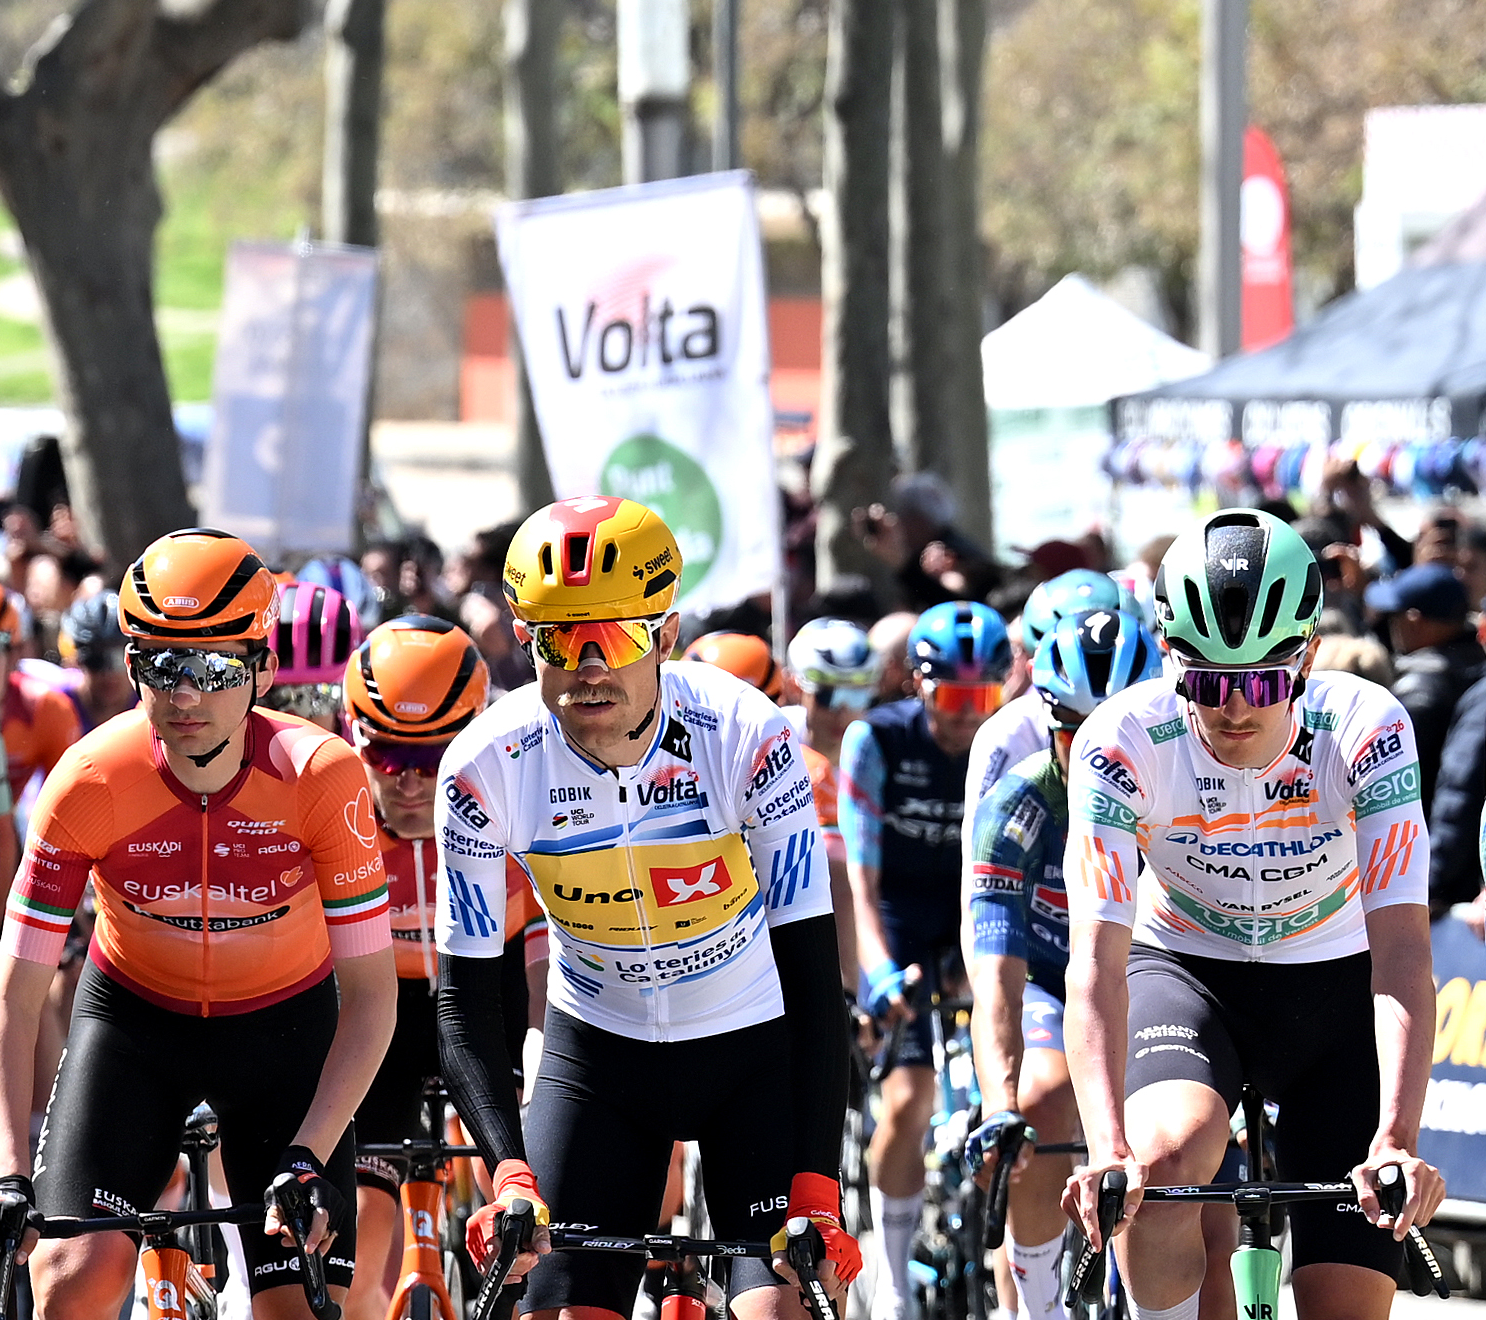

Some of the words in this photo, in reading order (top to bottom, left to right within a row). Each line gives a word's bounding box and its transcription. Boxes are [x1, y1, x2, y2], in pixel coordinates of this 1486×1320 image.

[556, 302, 720, 380] Volta
[644, 547, 674, 575] sweet
[167, 597, 195, 607] ABUS
[399, 703, 423, 712] ABUS
[745, 741, 794, 801] Volta
[1079, 739, 1138, 796] Volta
[550, 786, 592, 804] GOBIK
[637, 777, 698, 807] Volta
[227, 819, 286, 828] QUICK
[571, 812, 595, 821] WORLD
[237, 827, 278, 835] PRO
[1200, 828, 1344, 858] DECATHLON
[1185, 854, 1254, 882] CMA
[1259, 852, 1329, 882] CGM
[123, 879, 277, 903] euskaltel
[554, 882, 644, 905] Uno
[973, 878, 1023, 893] OUDAL
[1216, 899, 1255, 912] VAN
[1260, 888, 1313, 912] RYSEL
[162, 908, 280, 931] kutxabank
[1194, 901, 1319, 937] vera
[615, 939, 726, 974] Loteries
[725, 927, 747, 947] de
[616, 934, 747, 984] Catalunya
[94, 1188, 138, 1216] EUSKA
[581, 1239, 635, 1251] RIDLEY
[648, 1236, 674, 1245] GARMIN
[1408, 1225, 1442, 1279] SRAM
[255, 1260, 288, 1277] AGU
[472, 1261, 503, 1320] SRAM
